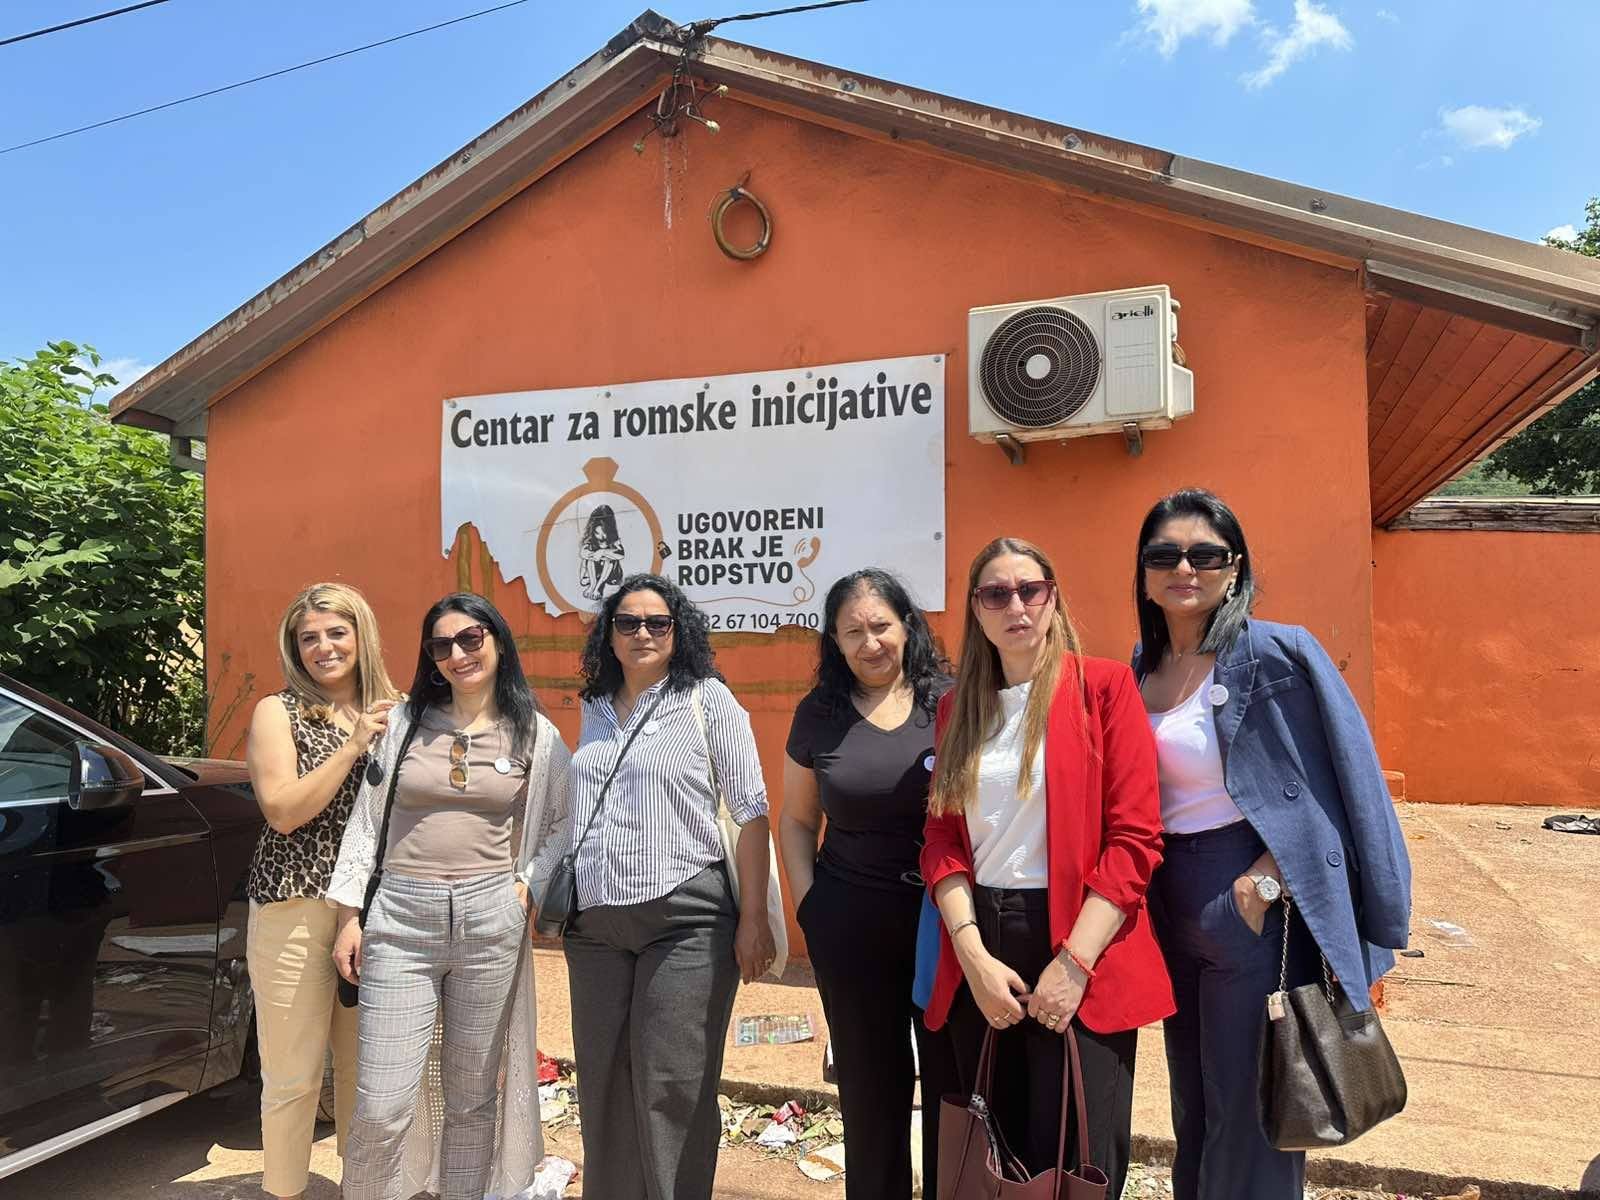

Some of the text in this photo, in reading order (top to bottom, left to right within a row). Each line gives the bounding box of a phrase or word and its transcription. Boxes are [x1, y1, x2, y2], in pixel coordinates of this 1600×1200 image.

[450, 371, 932, 448] Centar za romske inicijative
[677, 507, 824, 535] UGOVORENI
[678, 535, 784, 560] BRAK JE
[678, 561, 793, 586] ROPSTVO
[726, 614, 746, 629] 67
[750, 613, 781, 629] 104
[785, 612, 819, 628] 700
